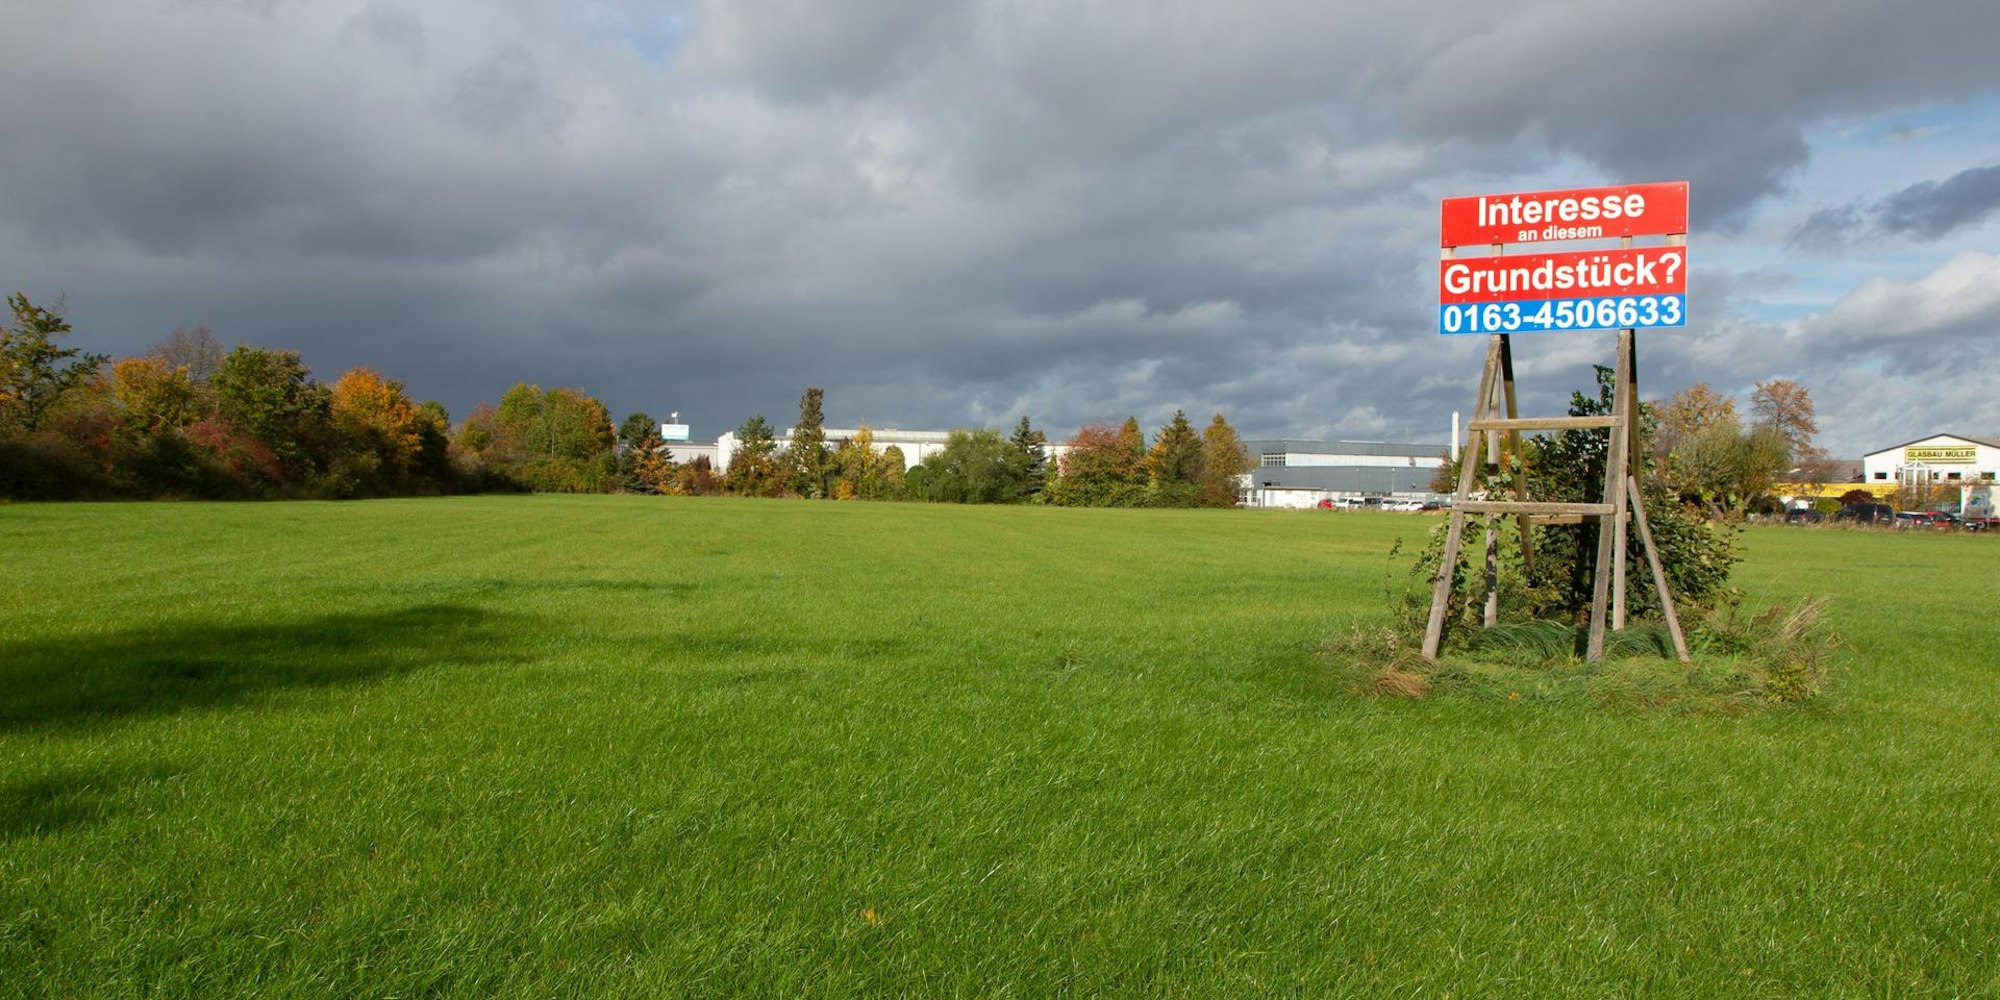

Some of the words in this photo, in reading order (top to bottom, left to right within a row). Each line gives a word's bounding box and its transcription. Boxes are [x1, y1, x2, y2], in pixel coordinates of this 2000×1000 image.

[1478, 193, 1645, 227] Interesse
[1518, 229, 1538, 242] an
[1543, 225, 1602, 240] diesem
[1444, 252, 1682, 294] Grundstück?
[1443, 296, 1681, 332] 0163-4506633
[1945, 449, 1976, 457] MÜLLER
